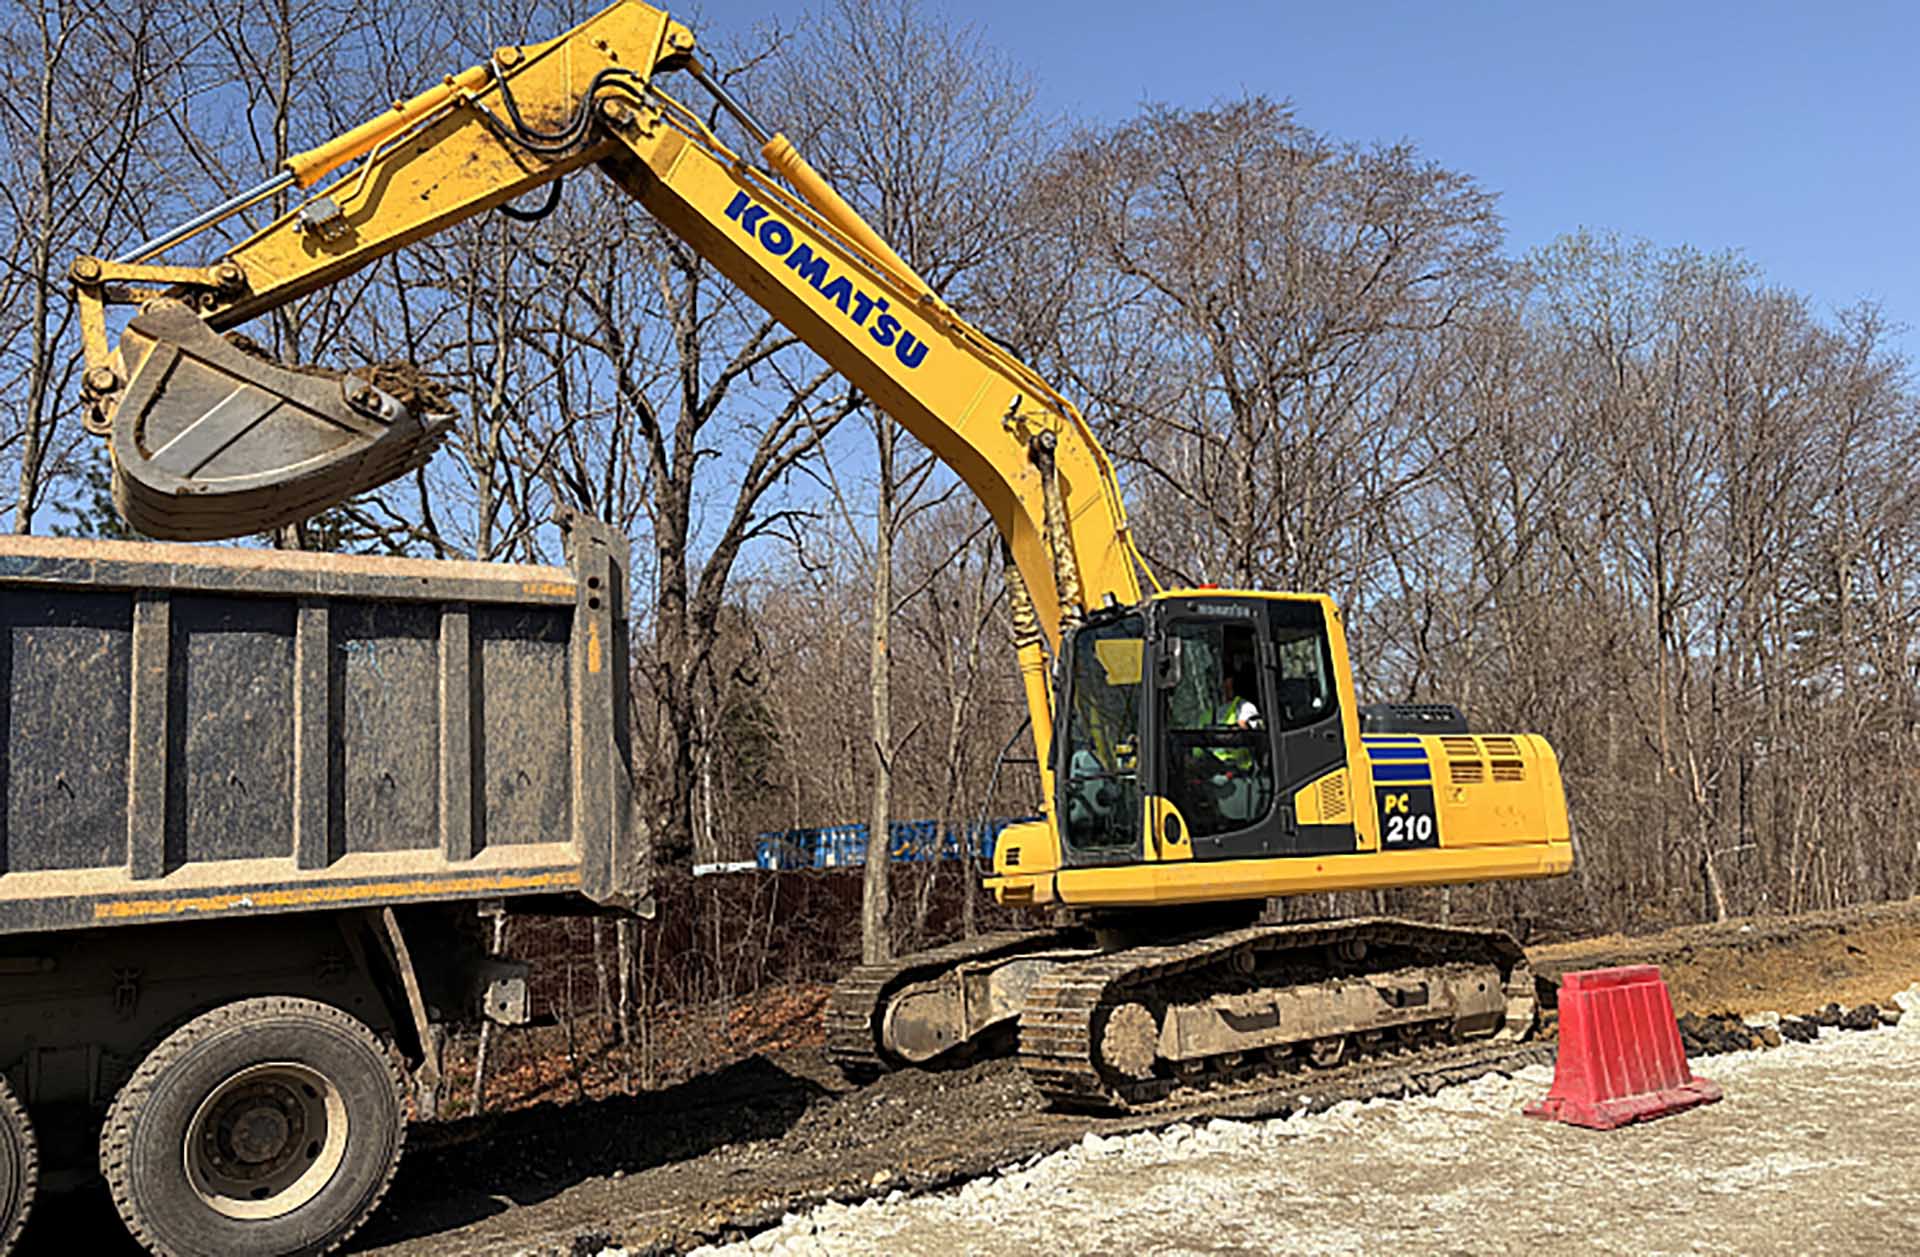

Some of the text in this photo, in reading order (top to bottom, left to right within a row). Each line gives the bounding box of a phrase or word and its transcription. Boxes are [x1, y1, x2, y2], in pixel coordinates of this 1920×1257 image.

[724, 191, 929, 369] KOMATSU
[1385, 793, 1409, 814] PC
[1386, 815, 1432, 842] 210
